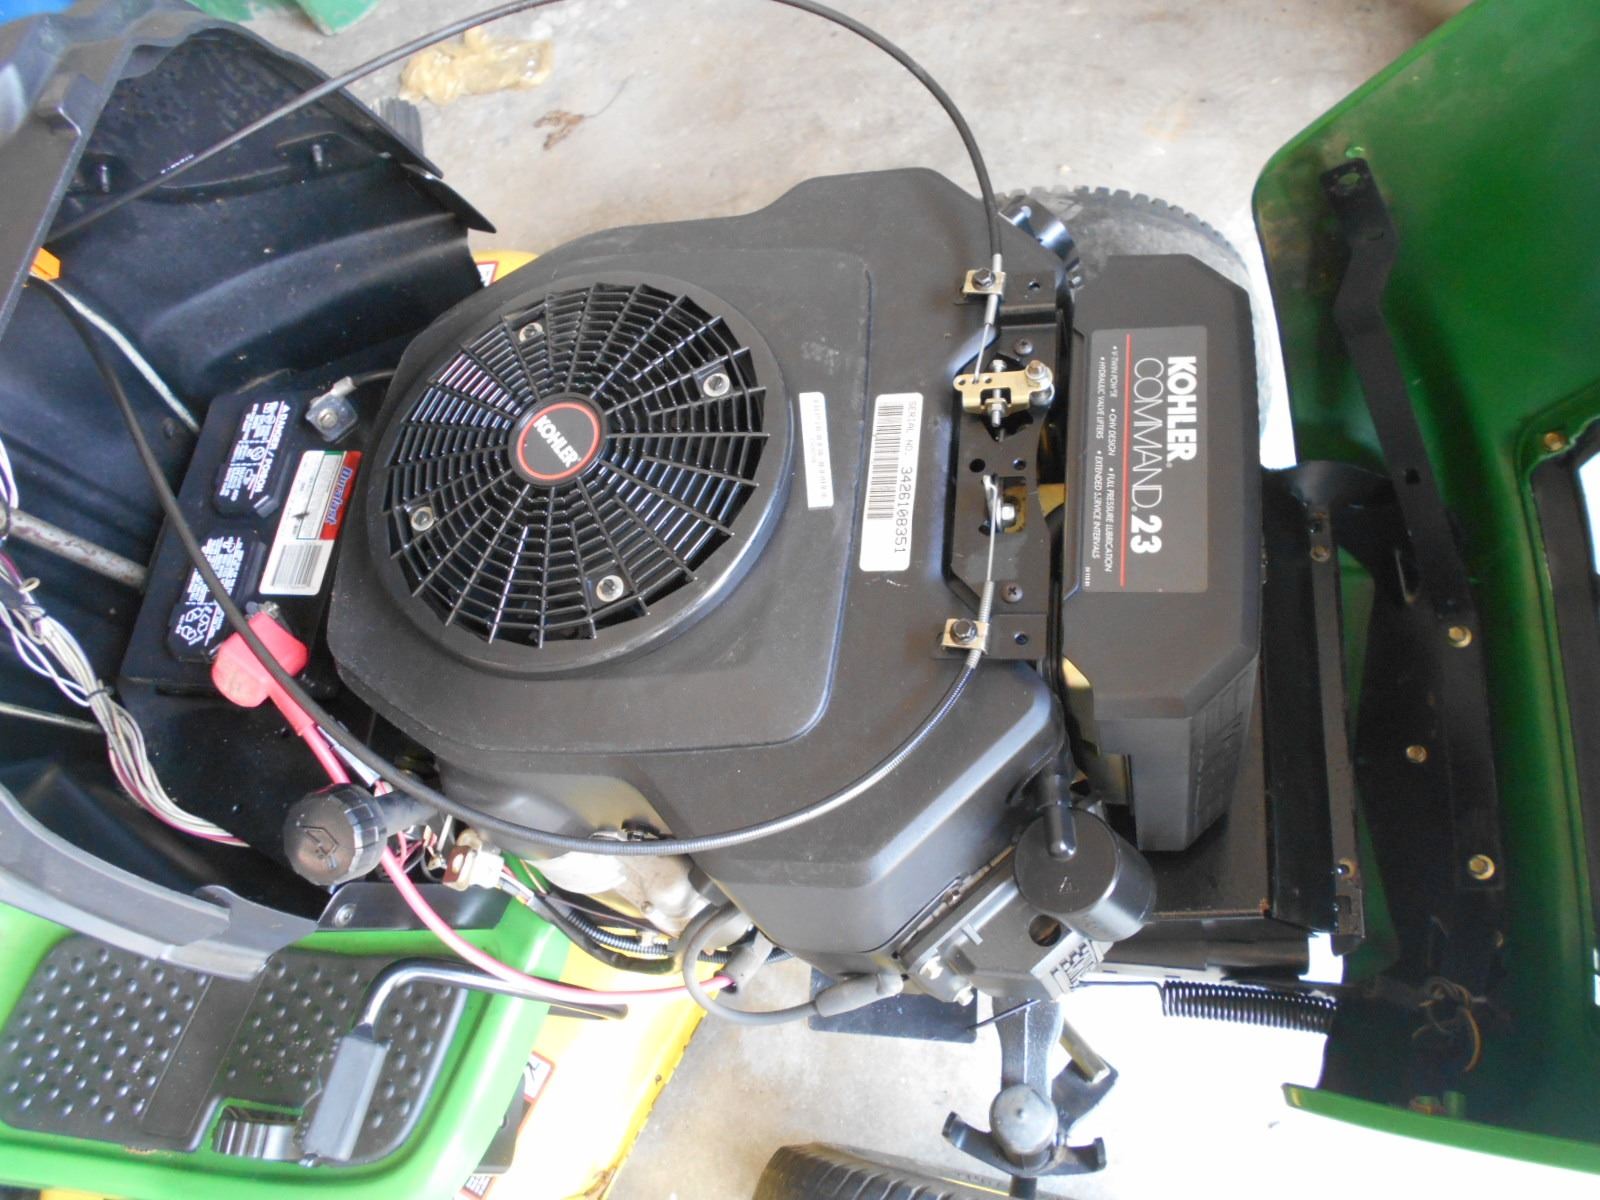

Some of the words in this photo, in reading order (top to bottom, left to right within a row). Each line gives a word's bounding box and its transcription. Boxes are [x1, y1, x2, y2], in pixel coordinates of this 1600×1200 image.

[1097, 361, 1106, 394] HYDRAULIC
[1110, 350, 1119, 373] V-TWIN
[907, 401, 917, 433] SERIAL
[1097, 395, 1105, 415] VALVE
[1108, 413, 1117, 429] OHV
[1166, 356, 1197, 463] KOHLER
[533, 414, 579, 469] KOHLER
[1096, 416, 1104, 439] LIFTERS
[1107, 430, 1116, 456] DESIGN
[1132, 358, 1164, 508] COMMAND
[1094, 456, 1103, 491] EXTENDED
[1106, 473, 1115, 488] FULL
[325, 466, 352, 525] Duralast
[894, 467, 913, 553] 3426108351
[1093, 492, 1102, 519] SERVICE
[1105, 489, 1115, 523] PRESSURE
[1092, 521, 1101, 559] INTERVALS
[1104, 524, 1114, 572] LUBRICATION
[1130, 514, 1162, 554] 23
